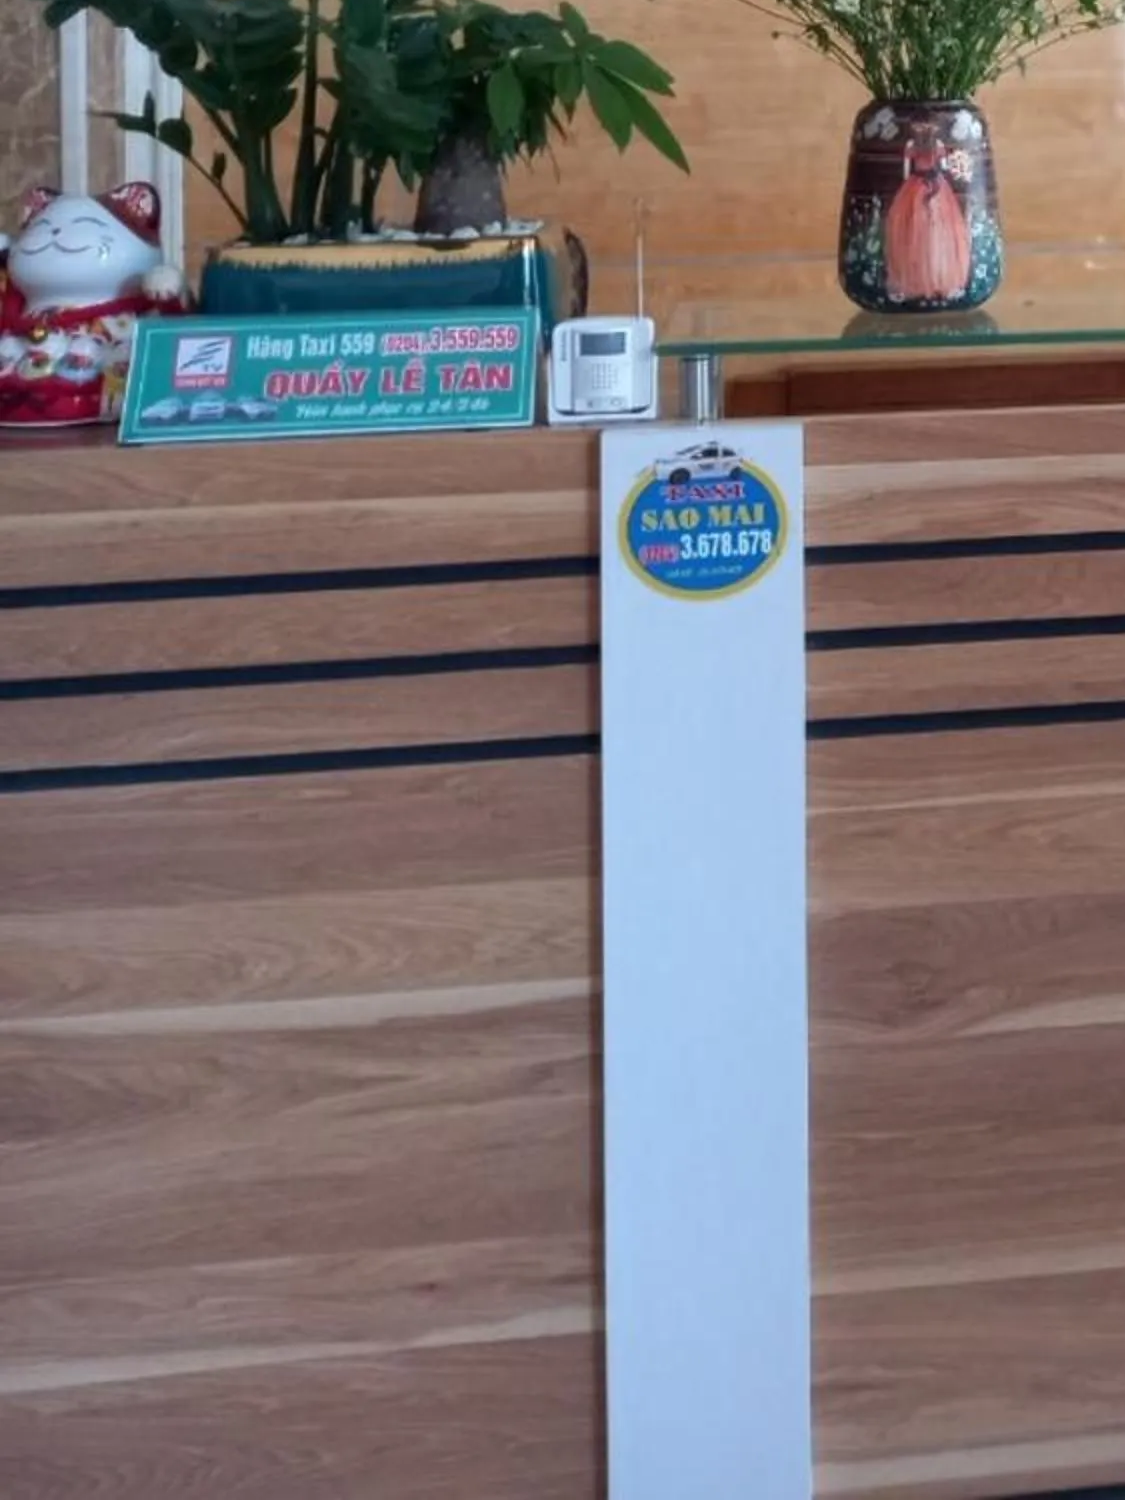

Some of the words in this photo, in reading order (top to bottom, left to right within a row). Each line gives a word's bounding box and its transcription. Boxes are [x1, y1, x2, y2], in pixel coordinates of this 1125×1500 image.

[301, 333, 336, 357] Taxi
[340, 331, 375, 355] 559
[437, 359, 514, 394] TÂN
[640, 507, 700, 532] SAO
[707, 503, 766, 528] MAI
[681, 530, 771, 559] 3.678.678
